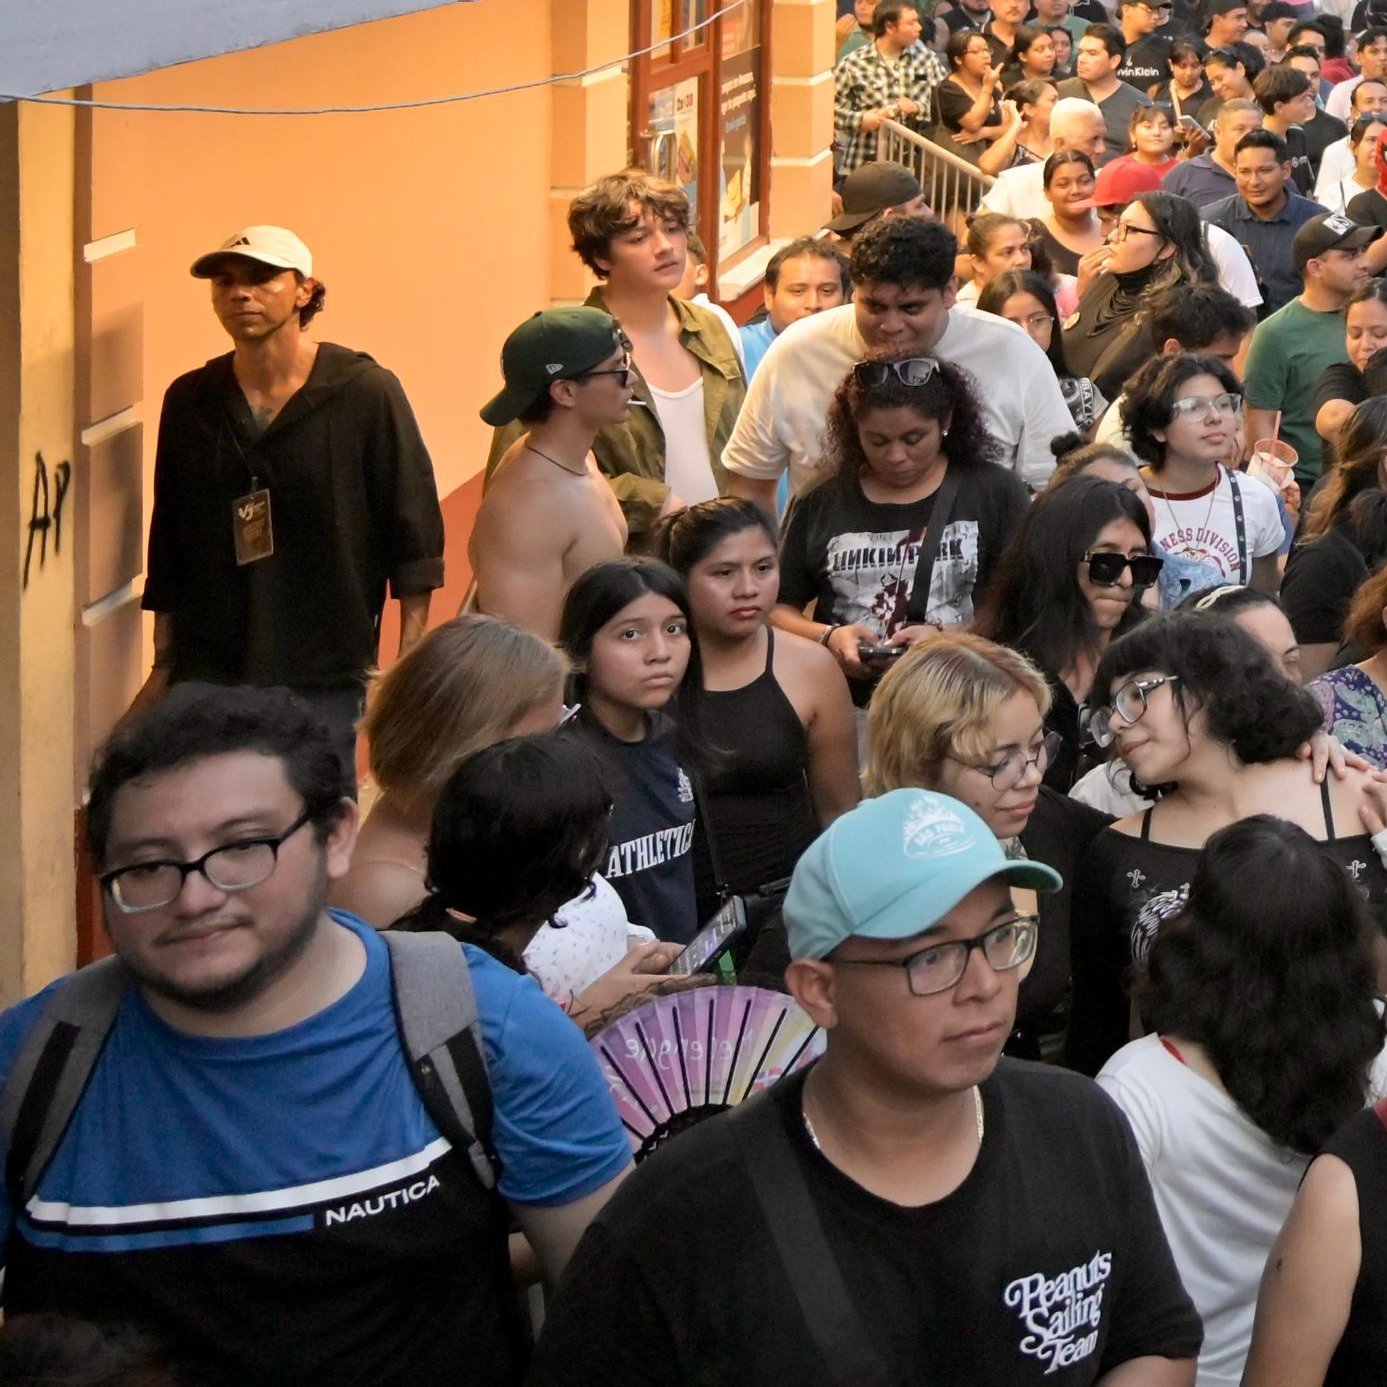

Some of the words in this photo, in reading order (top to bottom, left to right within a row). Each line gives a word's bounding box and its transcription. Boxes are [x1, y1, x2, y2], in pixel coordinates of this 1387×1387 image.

[908, 538, 964, 564] PRK
[1160, 528, 1193, 551] NESS
[1196, 528, 1241, 572] DIVISION
[325, 1175, 440, 1226] NAUTICA
[1004, 1249, 1112, 1319] Peanuts
[1020, 1282, 1105, 1354] Sailing
[1036, 1329, 1099, 1375] Team
